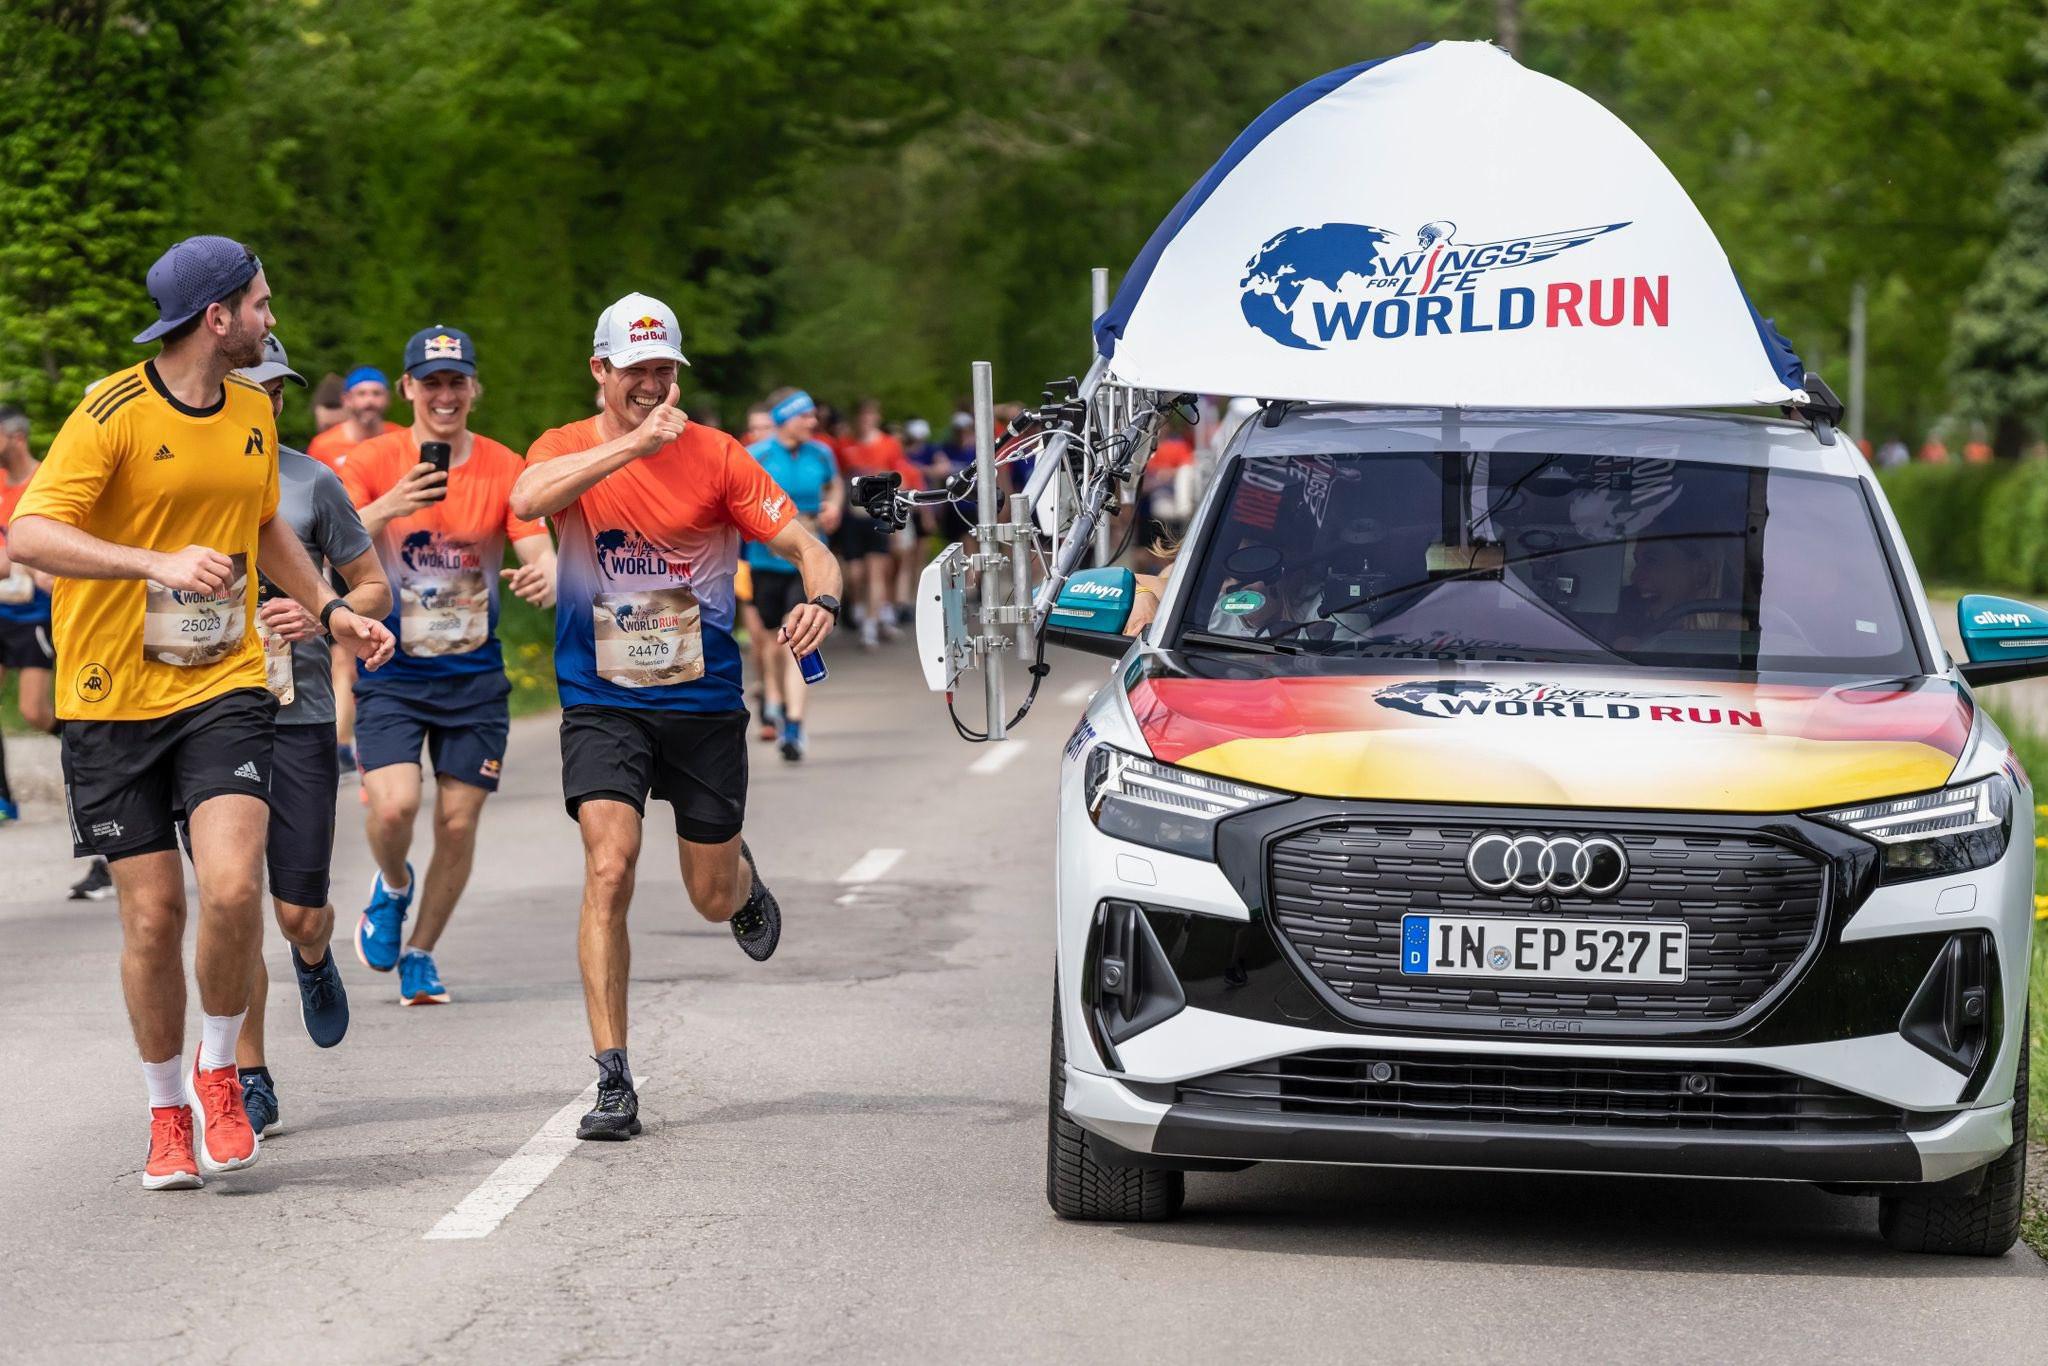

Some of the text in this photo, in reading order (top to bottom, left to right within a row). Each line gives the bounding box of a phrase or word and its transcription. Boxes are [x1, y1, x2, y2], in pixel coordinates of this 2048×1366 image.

[1379, 240, 1532, 278] WINGS
[1366, 278, 1400, 289] FOR
[1312, 275, 1669, 342] WORLD RUN
[630, 331, 667, 343] Red Bull
[418, 553, 460, 569] WORLD
[611, 556, 667, 575] WORLD
[1070, 581, 1123, 599] allwyn
[181, 616, 221, 632] 25023
[626, 618, 659, 631] WORLD
[660, 616, 679, 628] RUN
[1974, 611, 2032, 627] allwyn
[628, 643, 669, 657] 24476
[693, 663, 700, 673] 3
[1440, 699, 1762, 728] WORLD RUN
[234, 770, 260, 782] adidas
[1411, 952, 1421, 964] D
[1436, 924, 1485, 969] IN
